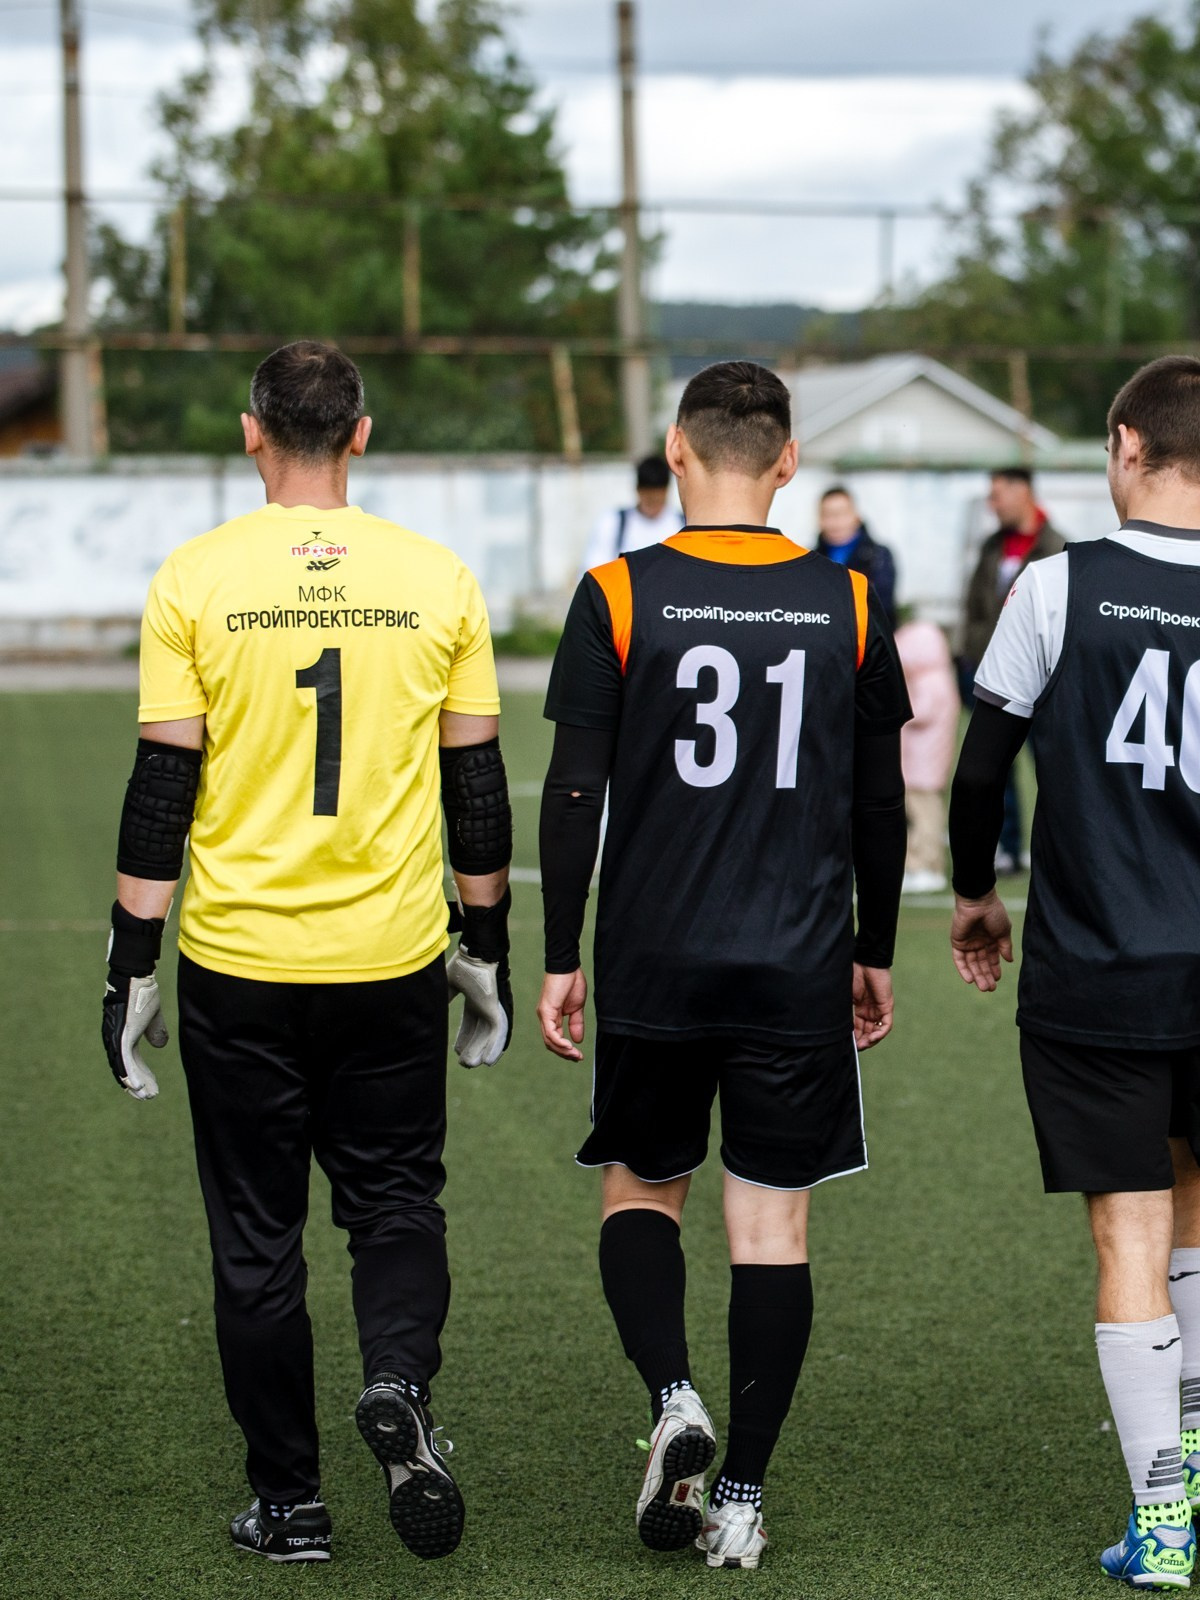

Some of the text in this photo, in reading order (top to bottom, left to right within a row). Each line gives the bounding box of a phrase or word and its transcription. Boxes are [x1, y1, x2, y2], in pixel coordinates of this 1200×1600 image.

[298, 585, 346, 602] МФК
[226, 605, 420, 632] СТРОЙПРОЕКТСЕРВИС
[662, 605, 831, 625] СтройПроектСервис
[674, 644, 806, 788] 31
[295, 647, 342, 817] 1
